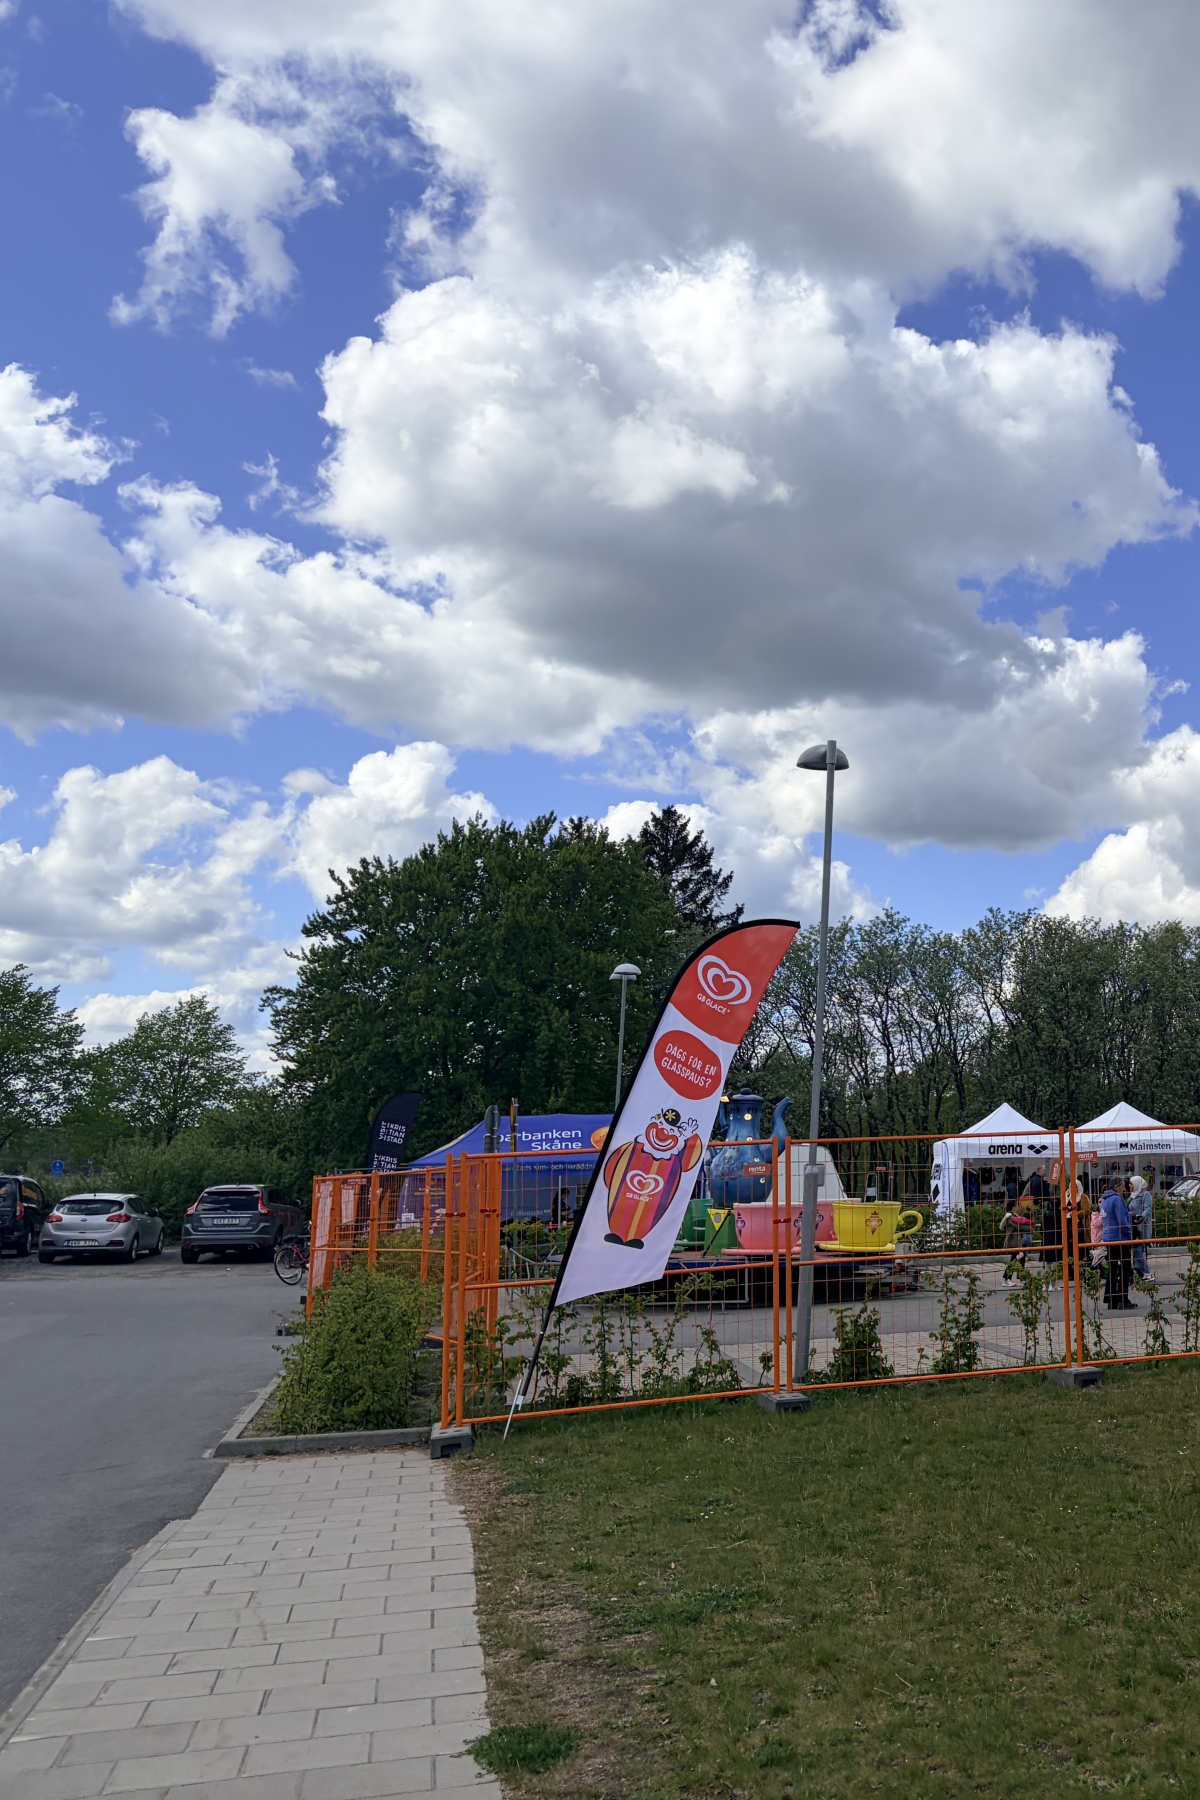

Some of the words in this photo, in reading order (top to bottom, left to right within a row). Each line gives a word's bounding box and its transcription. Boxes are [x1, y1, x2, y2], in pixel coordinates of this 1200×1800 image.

[705, 999, 728, 1015] GLACE
[665, 1043, 687, 1062] DAGS
[687, 1055, 703, 1071] FÖR
[704, 1064, 717, 1076] EN
[661, 1057, 712, 1088] GLASSPAUS?
[390, 1123, 406, 1132] KRIS
[389, 1129, 406, 1138] TIAN
[386, 1136, 403, 1145] STAD
[531, 1140, 582, 1151] Skåne
[988, 1144, 1023, 1155] arena
[1130, 1142, 1172, 1151] Malmsten
[381, 1155, 398, 1164] KRIS
[1051, 1162, 1060, 1180] renta
